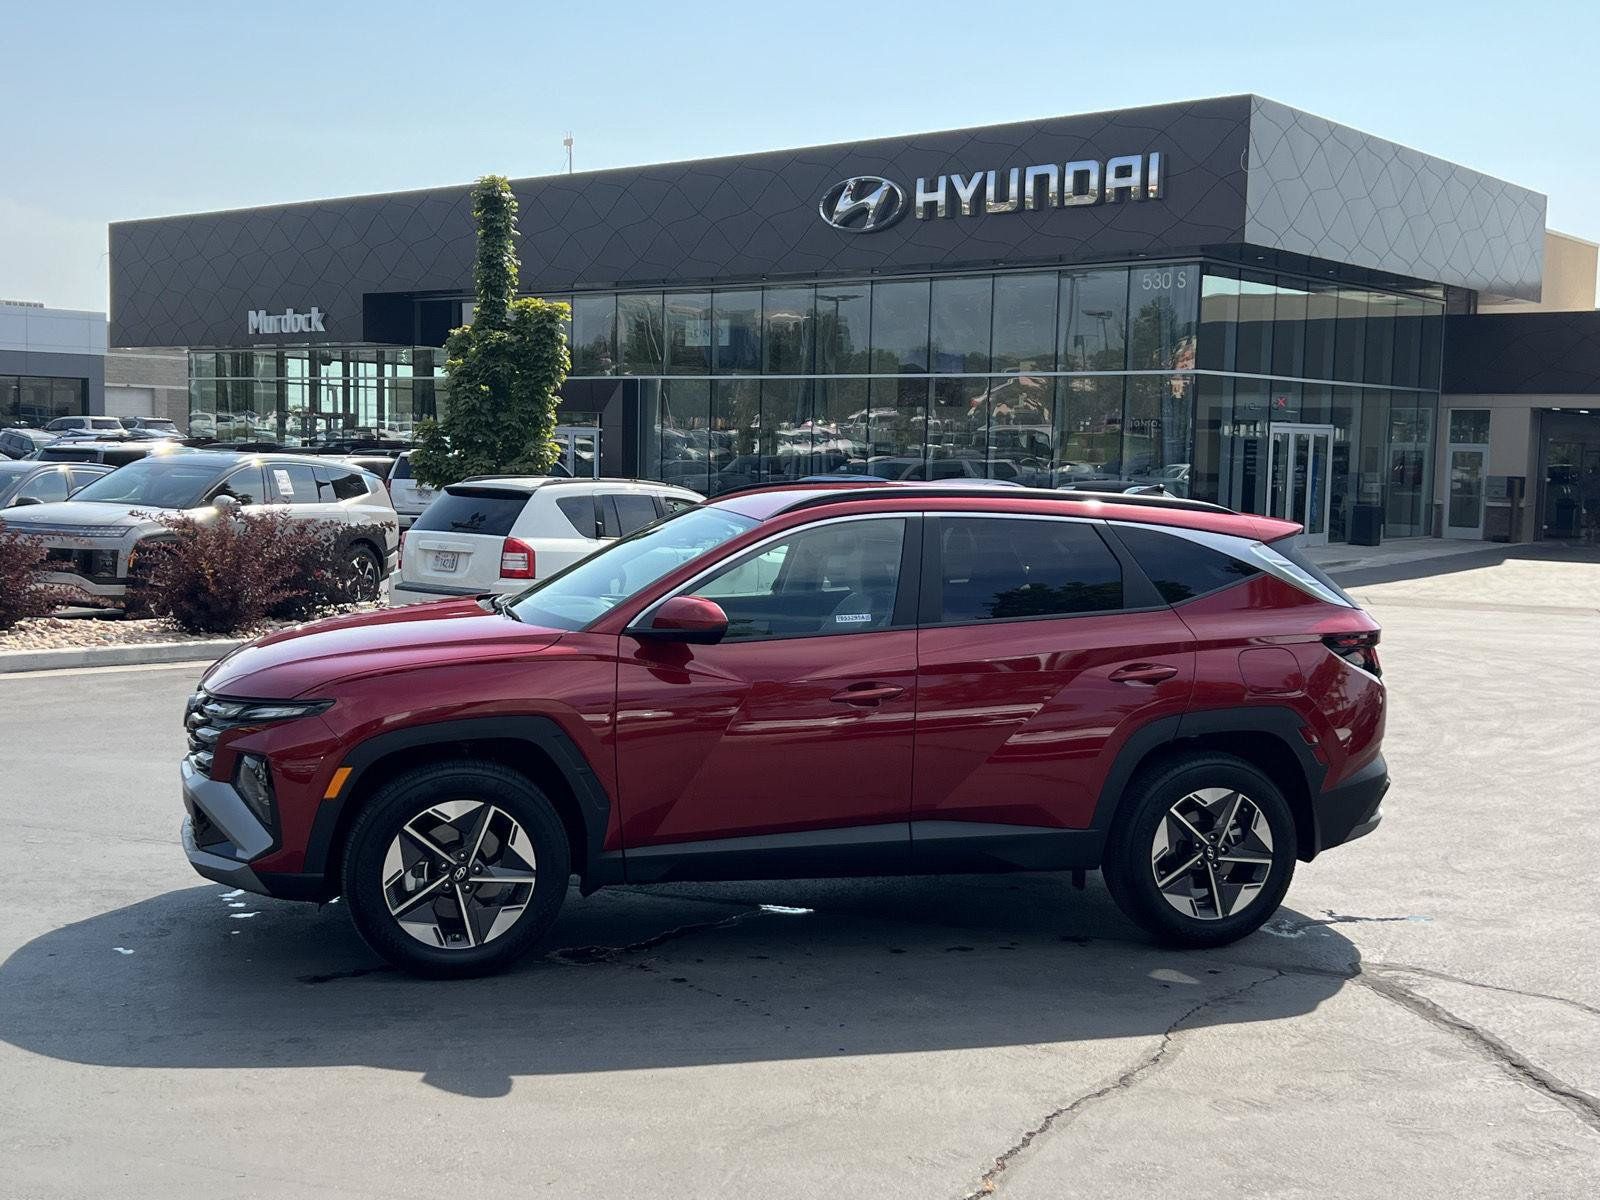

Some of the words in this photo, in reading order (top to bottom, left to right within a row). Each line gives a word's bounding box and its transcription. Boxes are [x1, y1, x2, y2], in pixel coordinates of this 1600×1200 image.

[915, 152, 1163, 219] HYUNDAI
[1142, 272, 1171, 290] 530
[1177, 271, 1186, 288] S
[248, 307, 326, 335] Murdock
